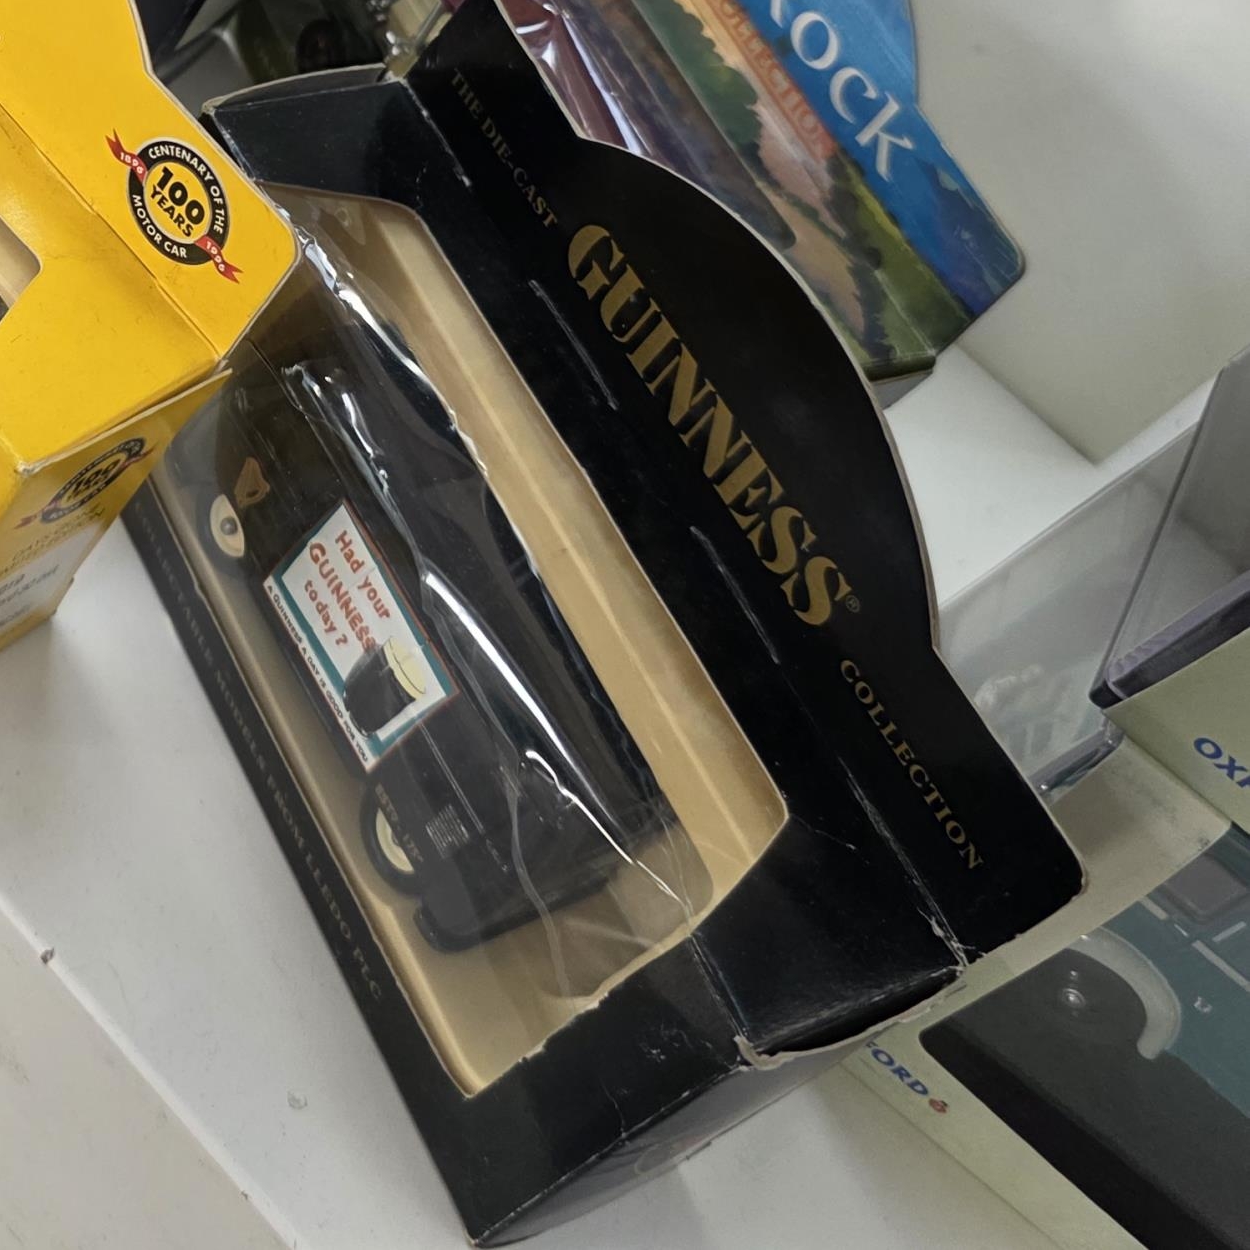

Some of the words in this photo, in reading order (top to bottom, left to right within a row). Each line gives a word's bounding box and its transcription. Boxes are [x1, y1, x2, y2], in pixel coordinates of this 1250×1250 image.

[149, 145, 214, 181] CENTENARY
[450, 67, 485, 123] THE
[482, 119, 559, 230] DIE-CAST
[150, 185, 194, 237] YEARS
[156, 166, 205, 225] 100
[210, 185, 224, 206] OF
[213, 208, 225, 234] THE
[132, 194, 162, 245] MOTOR
[164, 241, 187, 258] CAR
[308, 541, 377, 652] GUINNESS
[334, 529, 365, 574] Had
[355, 575, 391, 621] your
[303, 579, 337, 637] today
[841, 658, 985, 871] COLLECTION
